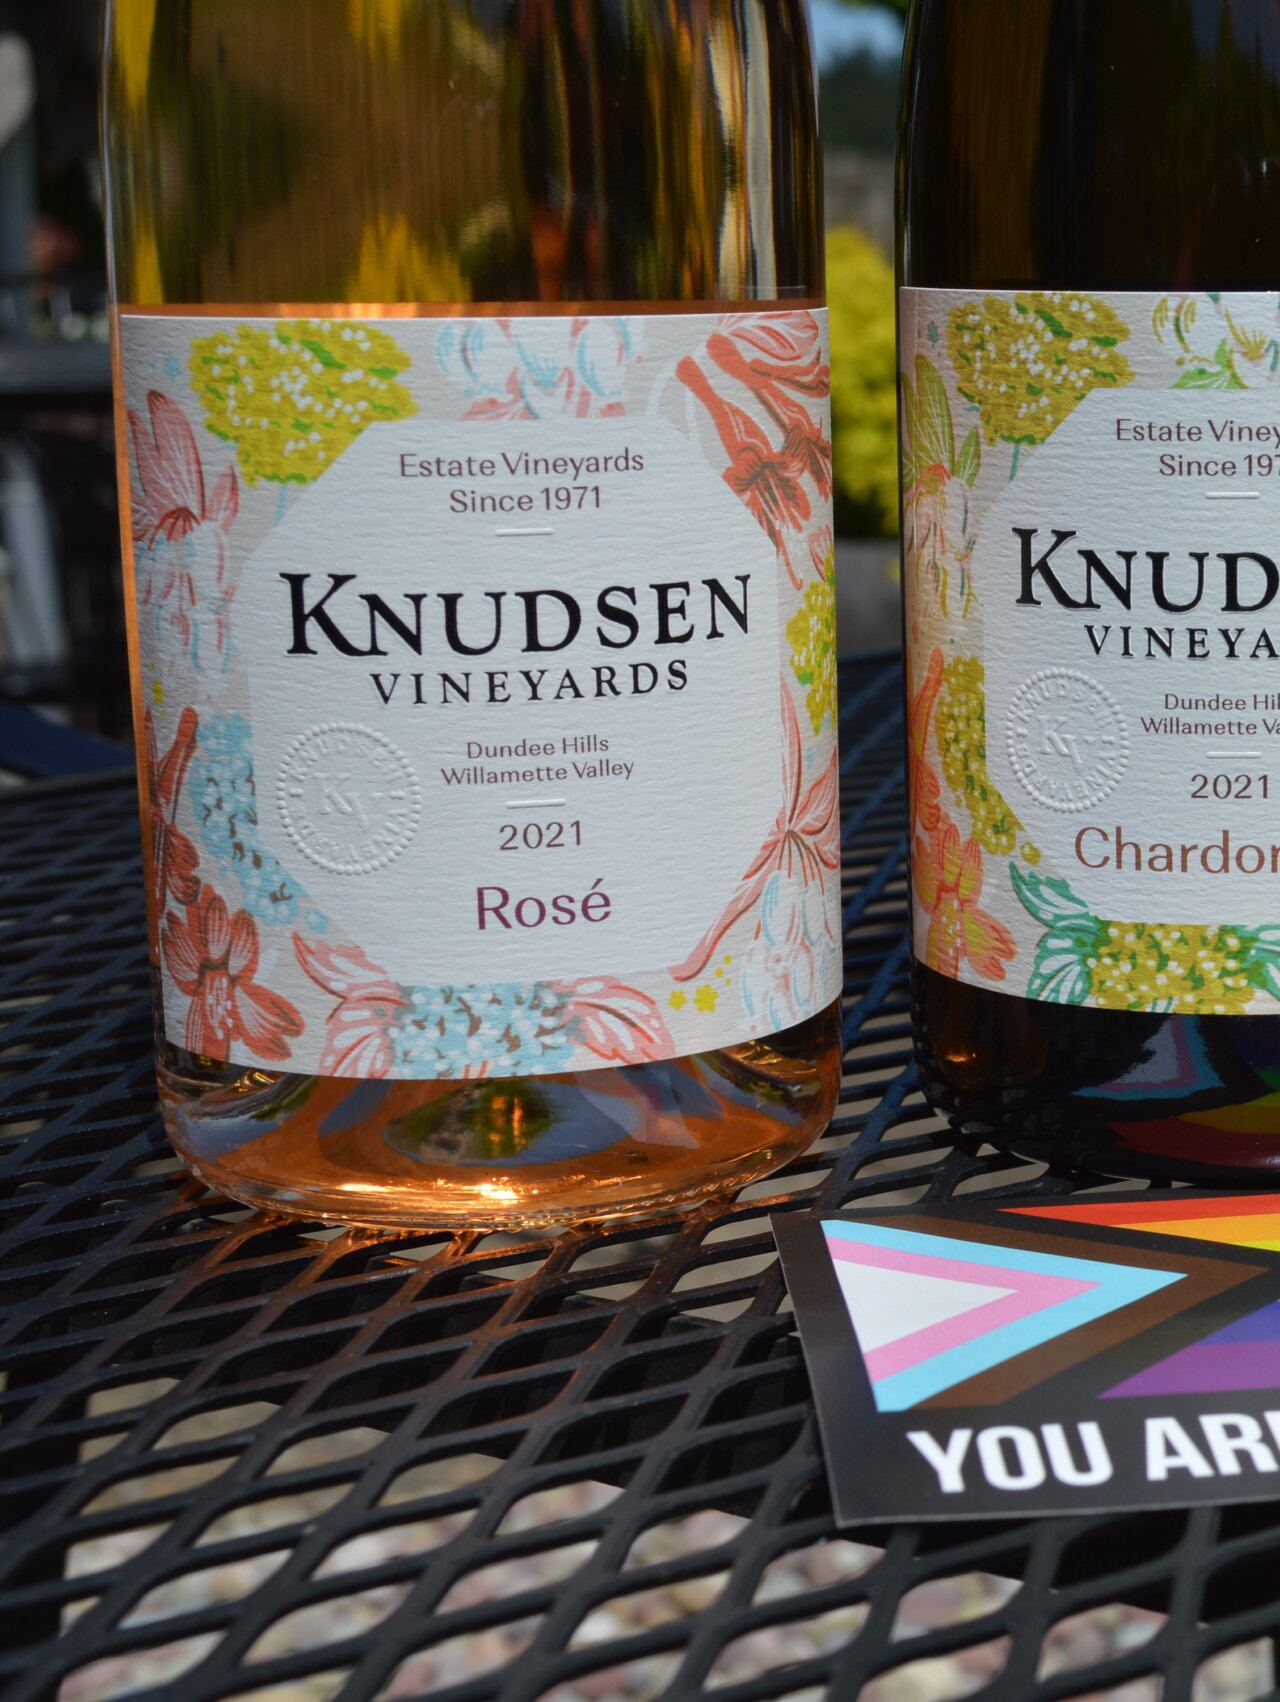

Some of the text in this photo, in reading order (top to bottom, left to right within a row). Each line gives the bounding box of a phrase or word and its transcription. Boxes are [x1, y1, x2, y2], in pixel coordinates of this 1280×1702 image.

[1116, 418, 1203, 443] Estate
[400, 447, 644, 480] Estate Vineyards
[1159, 454, 1237, 477] Since
[449, 485, 602, 513] Since 1971
[279, 572, 752, 658] KNUDSEN
[370, 659, 688, 705] VINEYARDS
[1164, 693, 1246, 712] Dundee
[1140, 717, 1257, 736] Willamette
[466, 735, 609, 759] Dundee Hills
[440, 759, 634, 785] Willamette Valley
[1190, 773, 1271, 800] 2021
[499, 820, 582, 850] 2021
[476, 878, 611, 931] Rosé
[906, 1421, 1113, 1493] YOU
